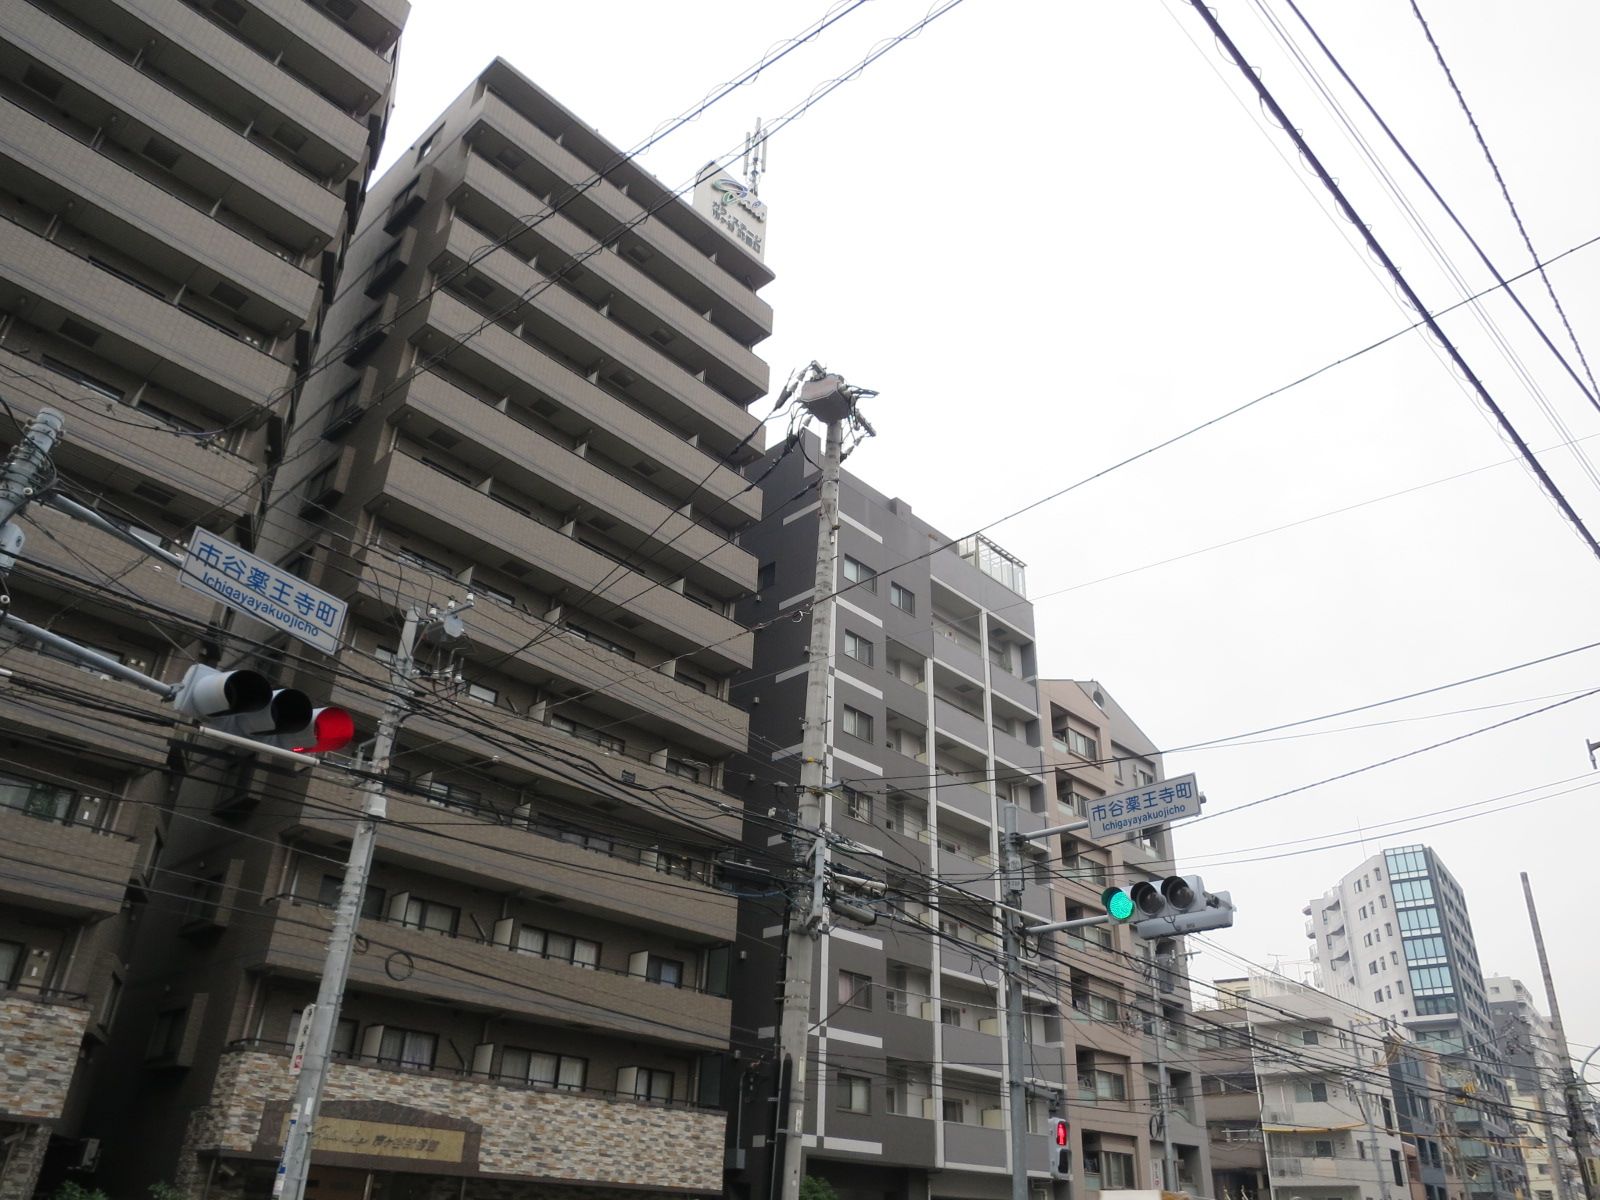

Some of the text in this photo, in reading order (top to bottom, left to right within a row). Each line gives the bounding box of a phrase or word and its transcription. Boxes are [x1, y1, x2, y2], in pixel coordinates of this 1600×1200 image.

[195, 541, 338, 628] 市谷薬王寺町
[202, 571, 320, 637] Ichigayayakuojicho
[1091, 781, 1193, 822] 市谷薬王寺町
[1102, 803, 1186, 832] Ichigayayakuojicho
